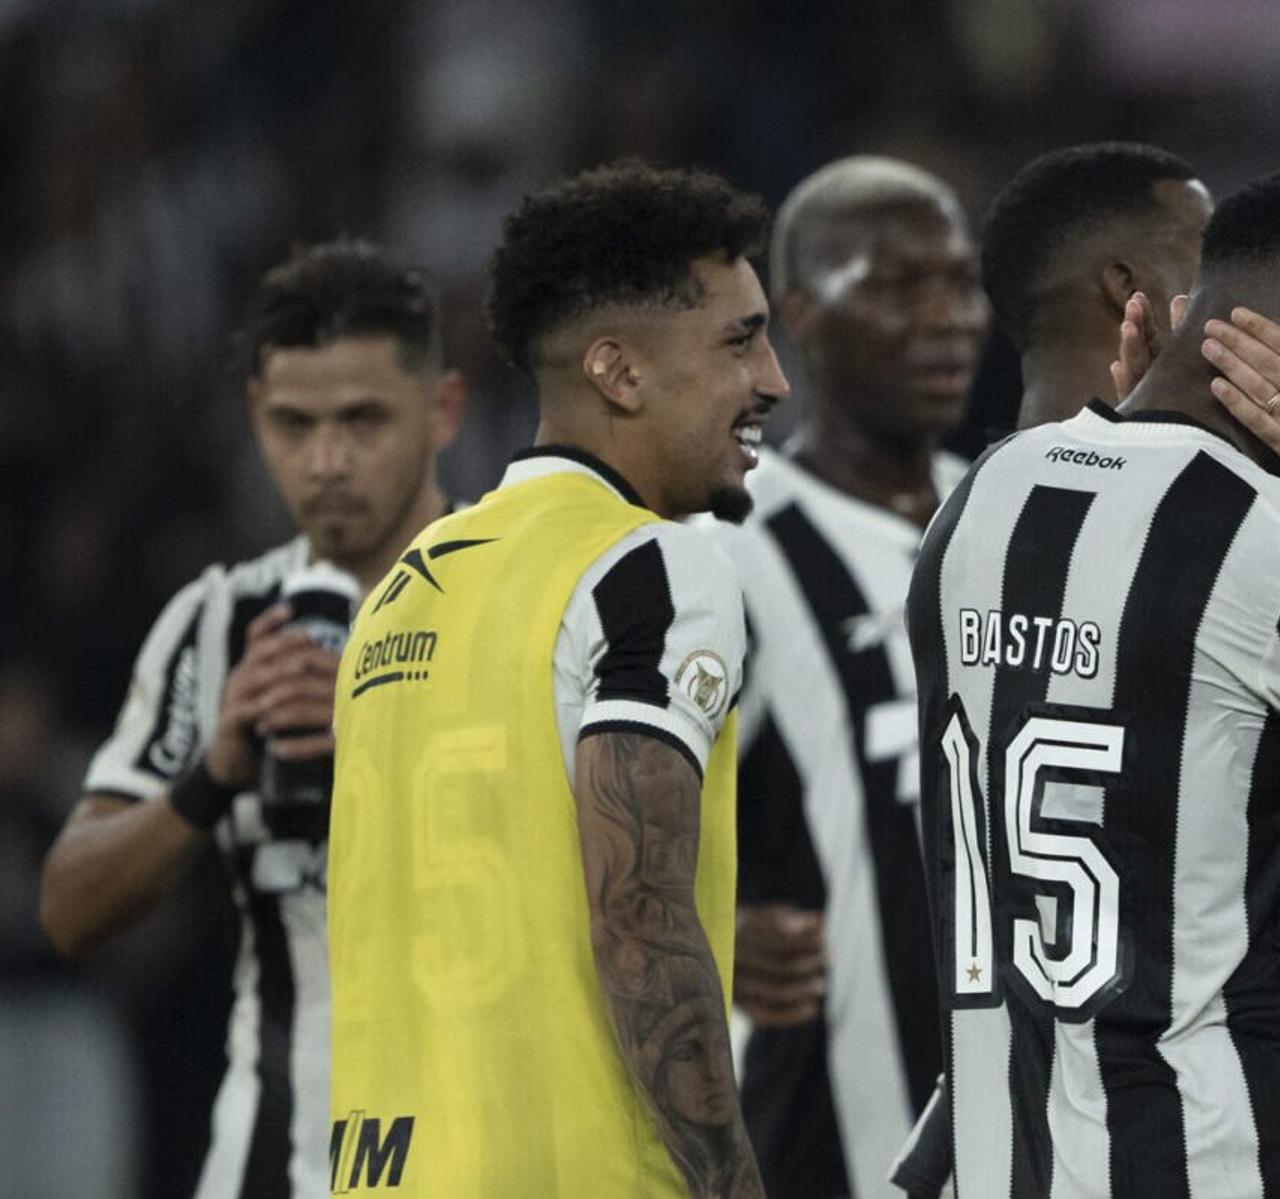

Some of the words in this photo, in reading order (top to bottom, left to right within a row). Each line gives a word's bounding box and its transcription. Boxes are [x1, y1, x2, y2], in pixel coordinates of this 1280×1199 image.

[1046, 446, 1127, 472] Reebok
[355, 629, 438, 681] Centrum
[958, 608, 1101, 680] BASTOS
[941, 712, 1126, 1009] 15
